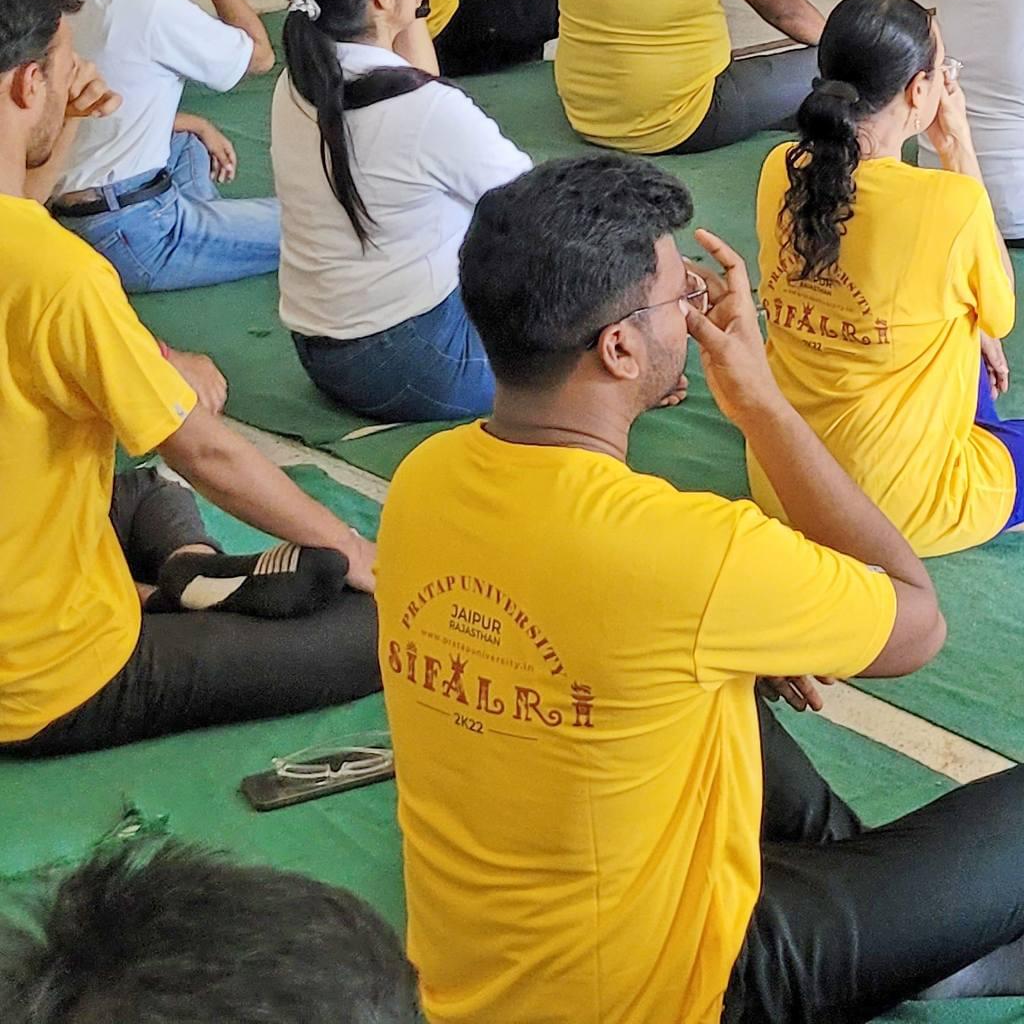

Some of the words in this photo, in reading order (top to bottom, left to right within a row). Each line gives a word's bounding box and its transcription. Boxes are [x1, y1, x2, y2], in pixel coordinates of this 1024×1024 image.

[401, 576, 456, 630] PRATAP
[461, 576, 567, 677] UNIVERSITY
[449, 620, 501, 647] RAJASTHAN
[451, 603, 502, 635] JAIPUR
[453, 712, 484, 735] 2K22
